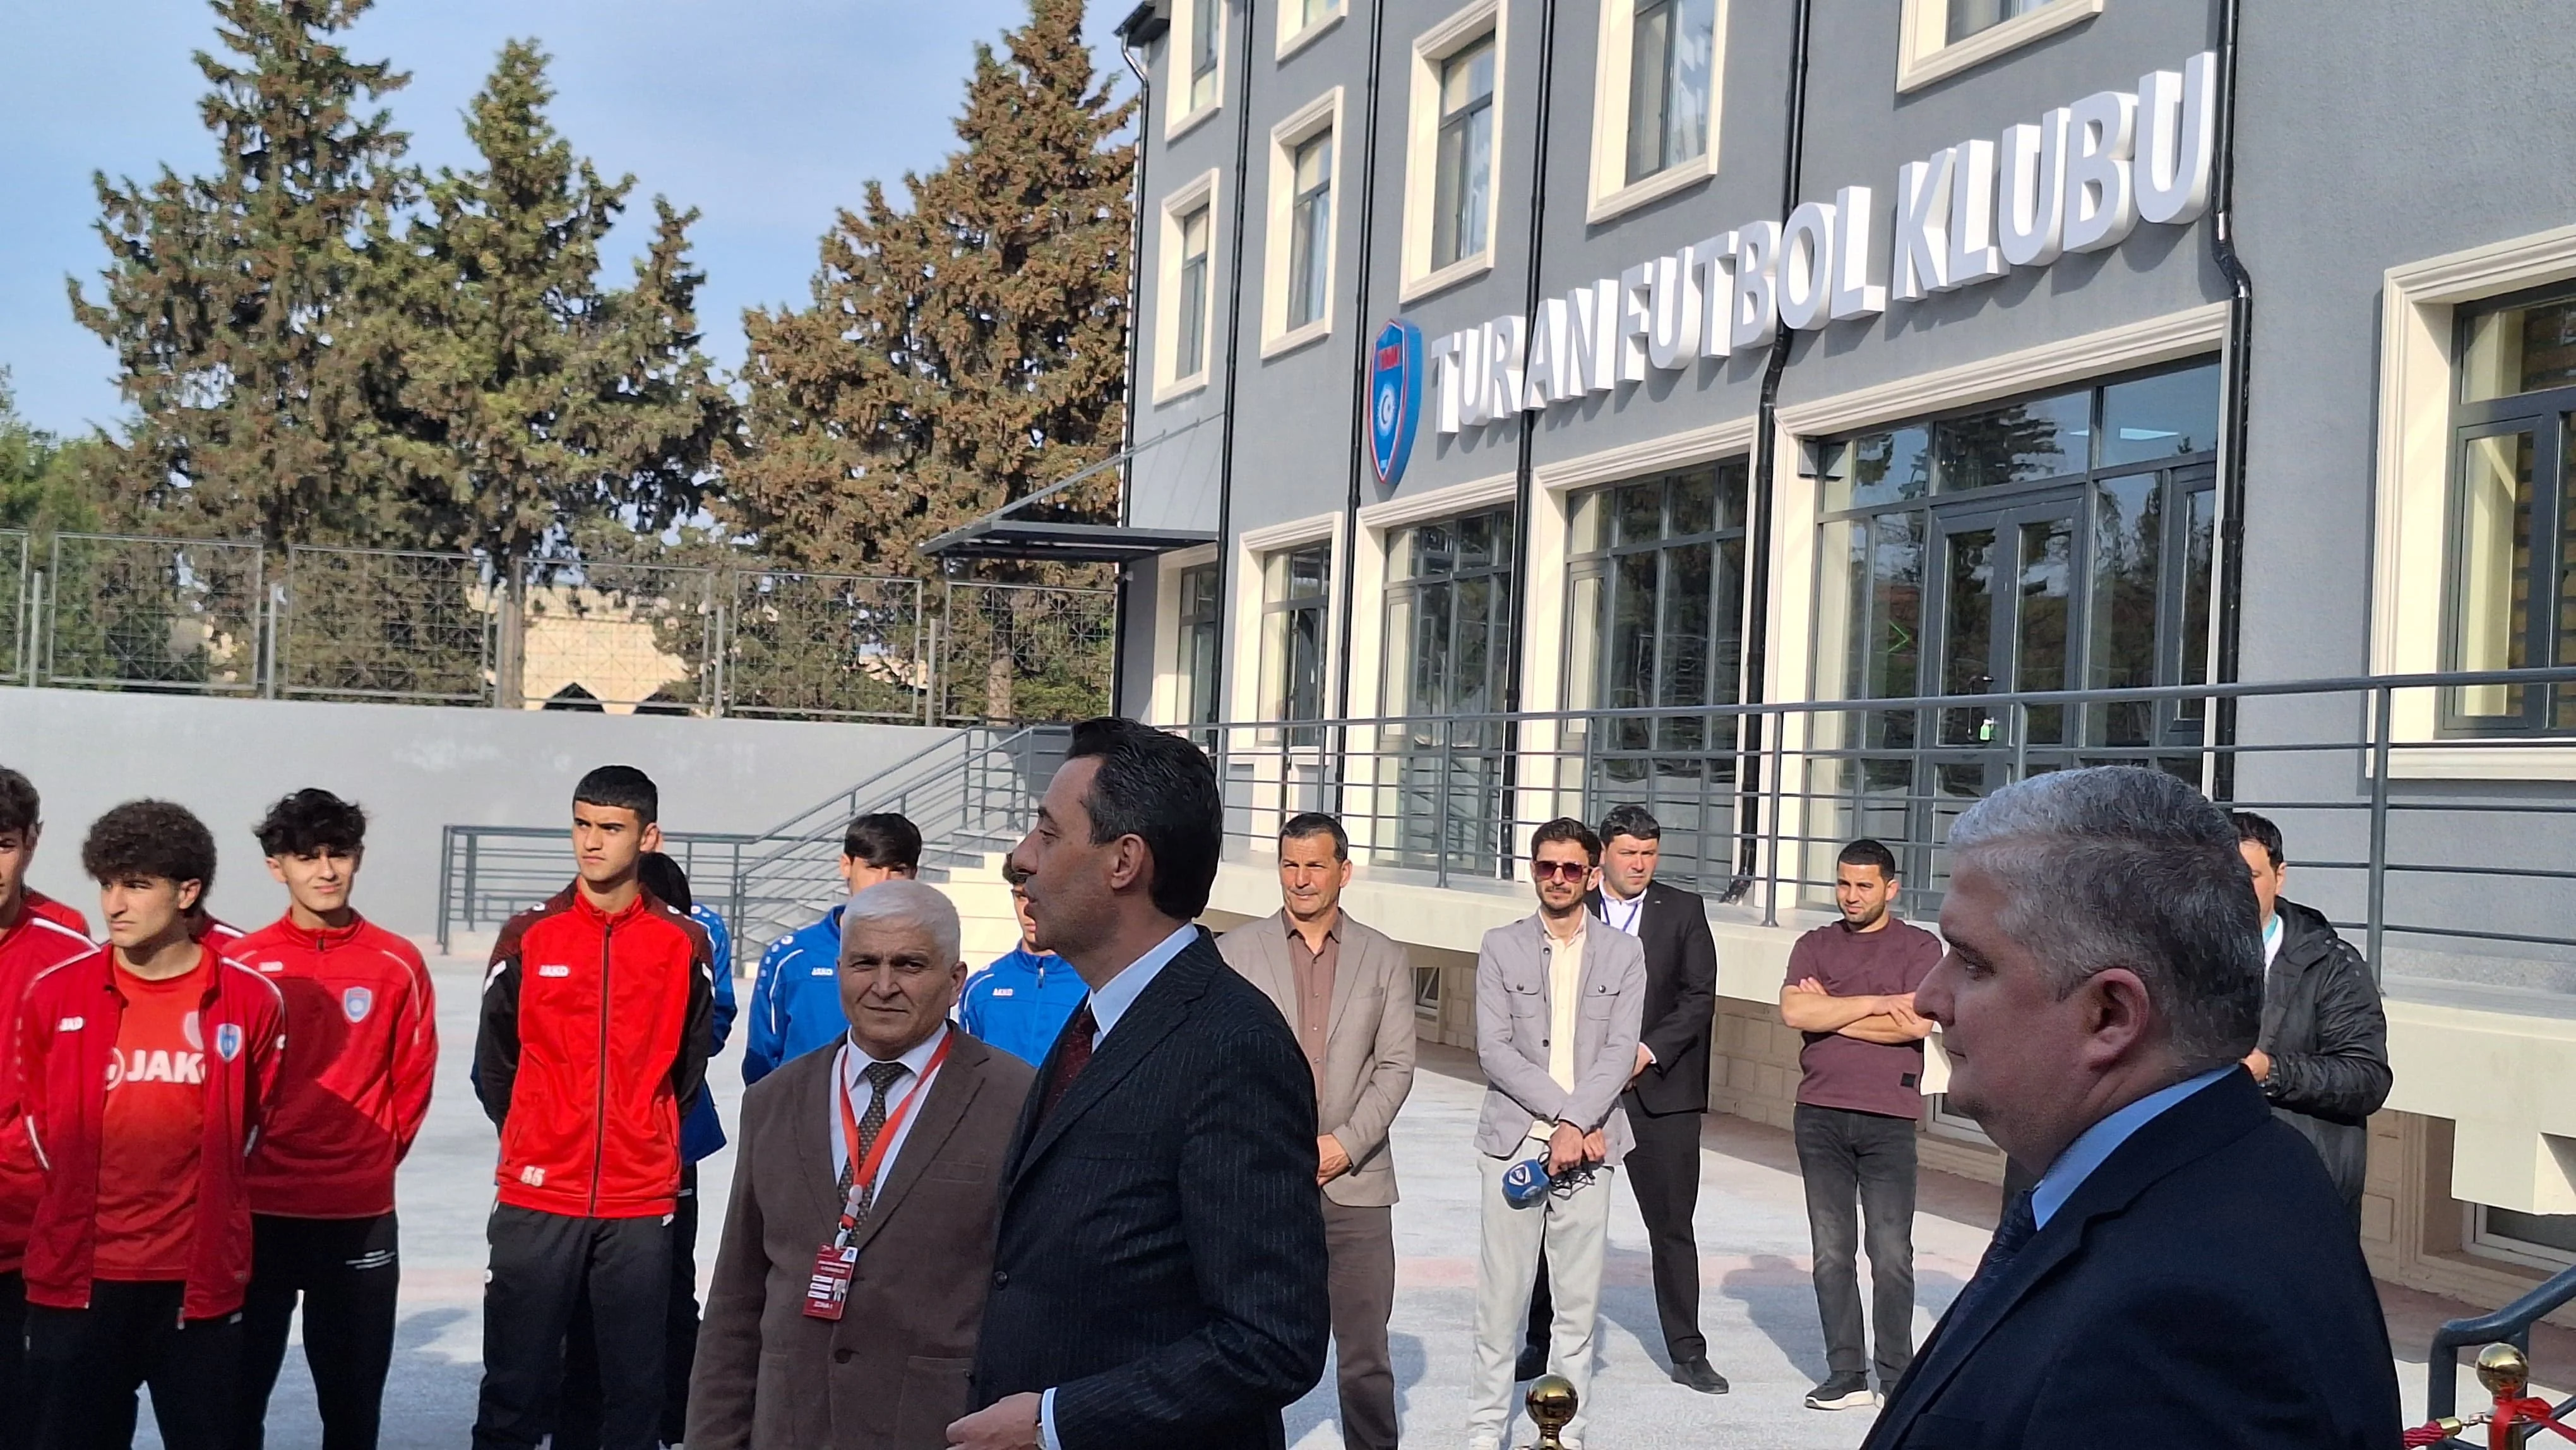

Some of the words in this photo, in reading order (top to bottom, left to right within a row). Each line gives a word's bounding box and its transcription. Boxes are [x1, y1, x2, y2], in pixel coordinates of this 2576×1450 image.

[1430, 279, 1619, 434] TURAN
[1617, 186, 1886, 381] FUTBOL
[1893, 51, 2217, 302] KLUBU
[126, 1049, 206, 1084] JAK
